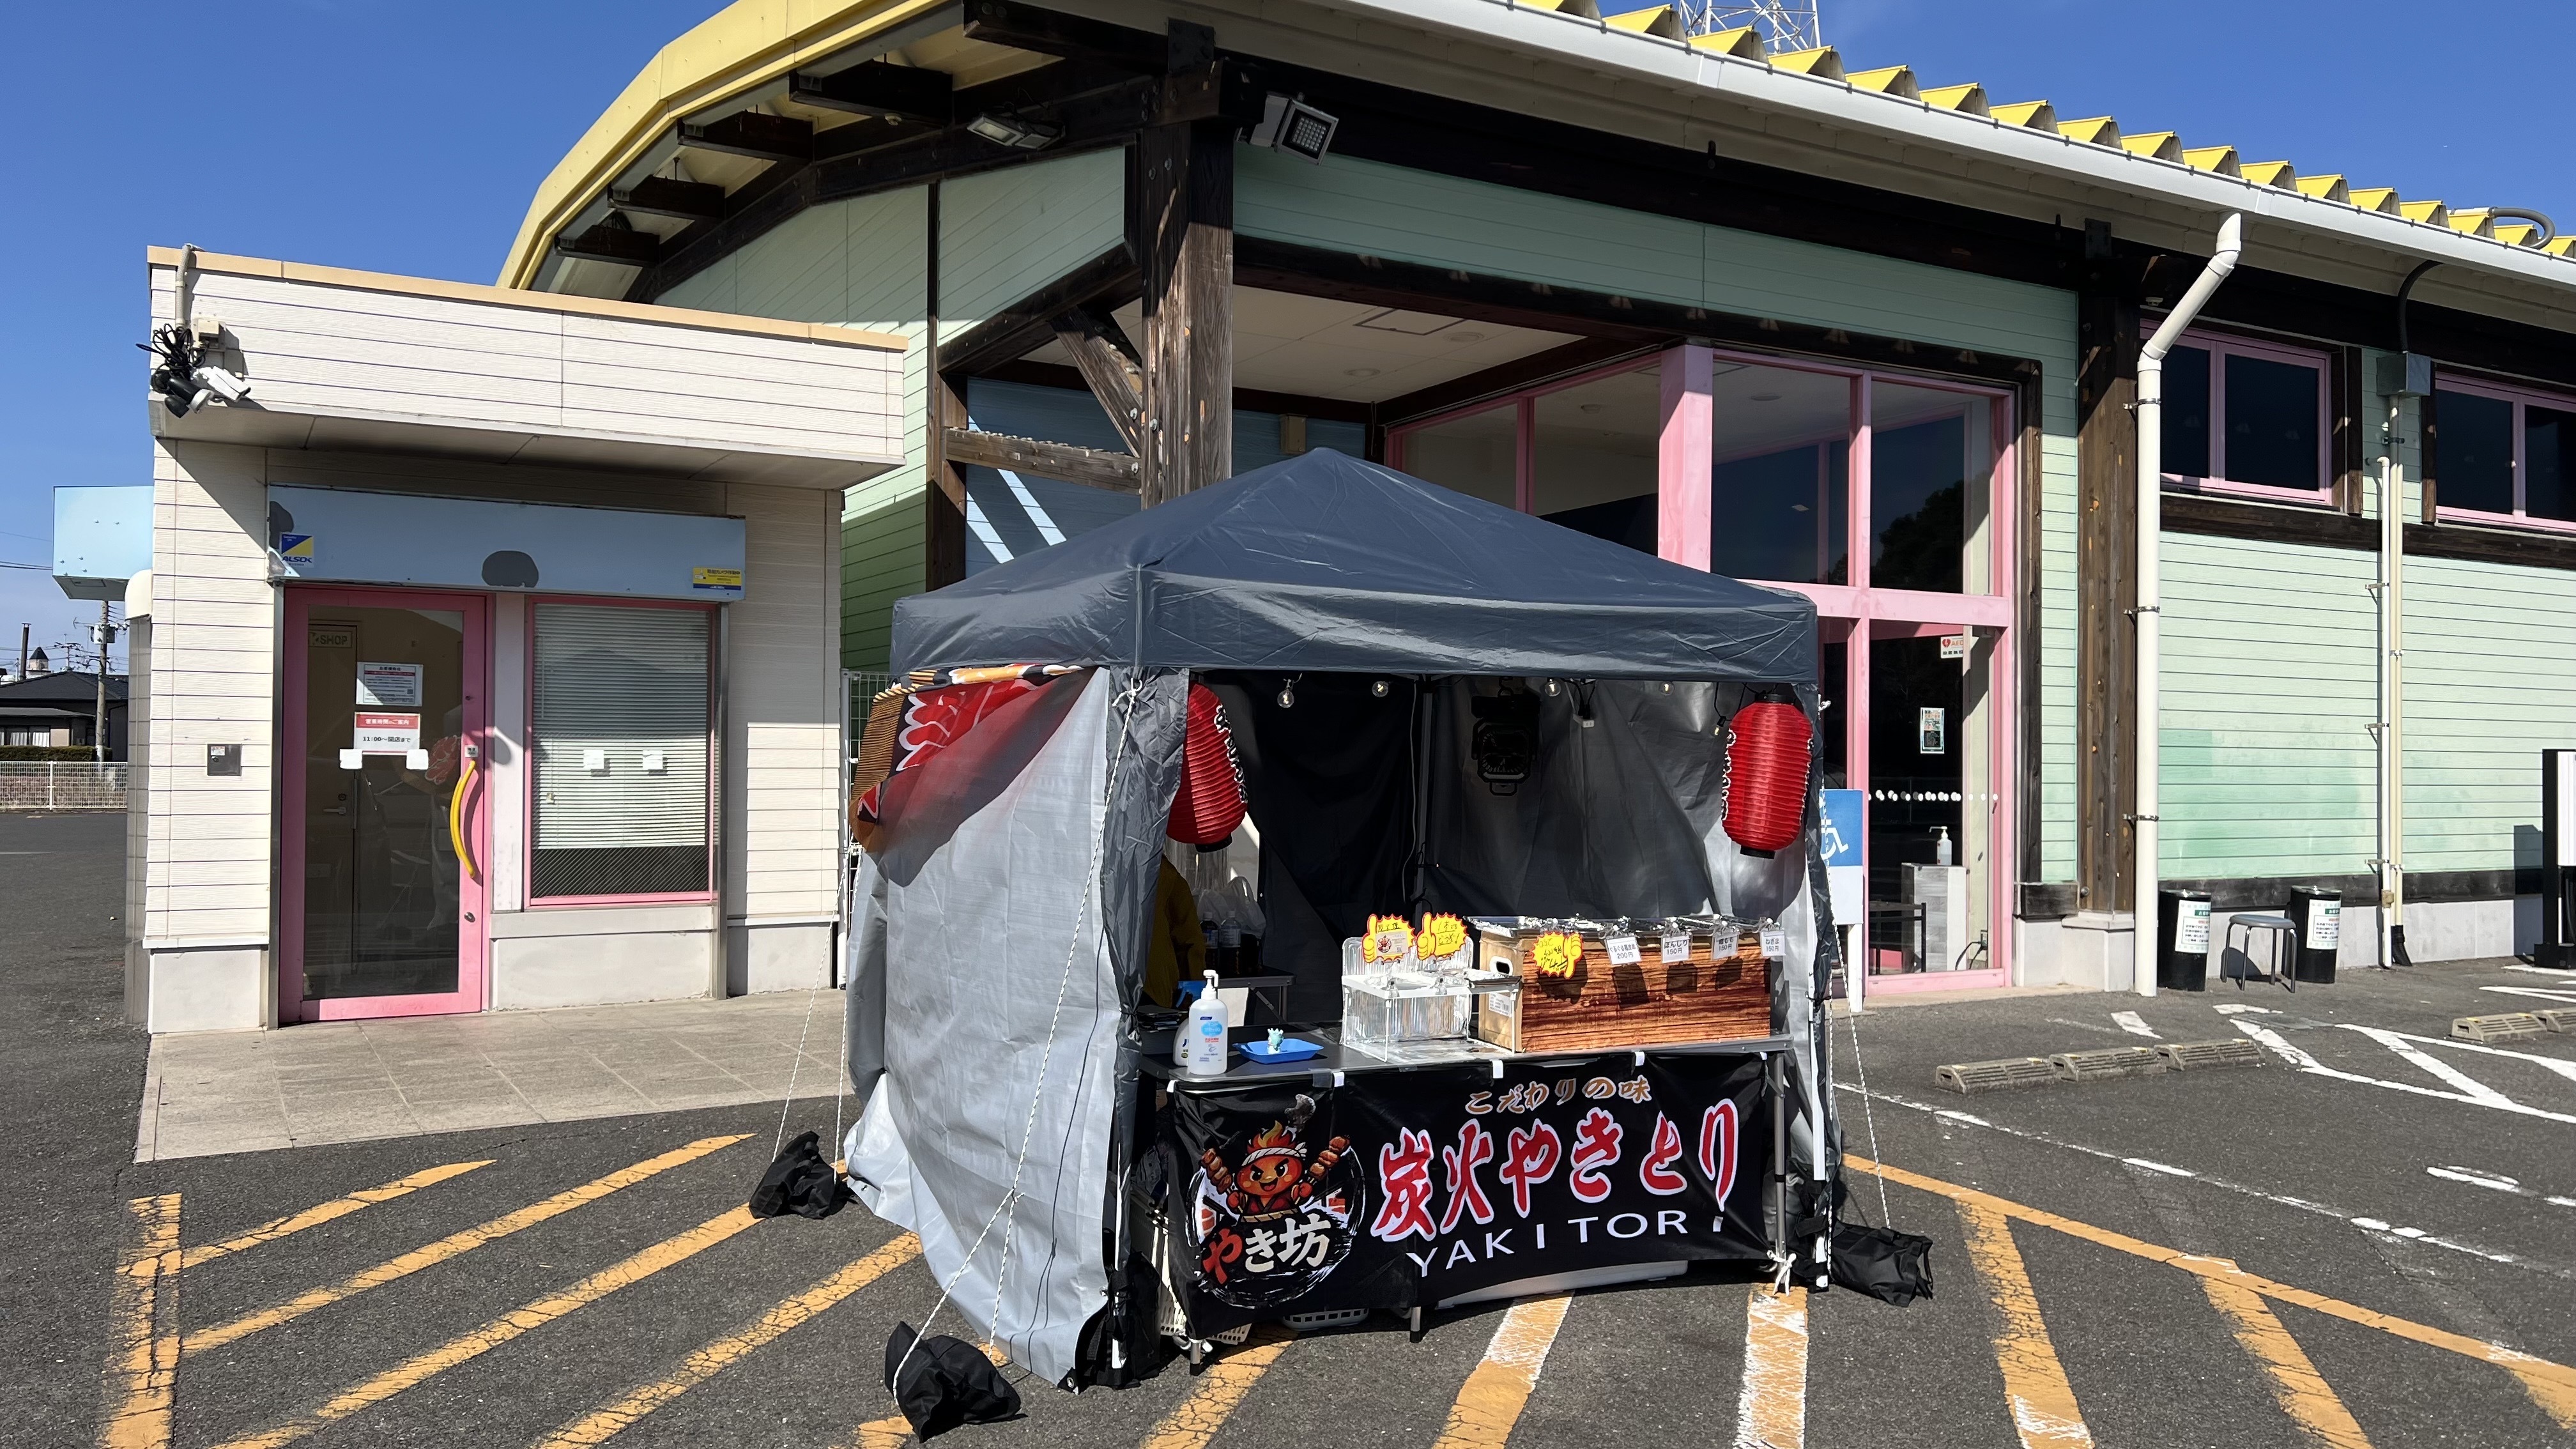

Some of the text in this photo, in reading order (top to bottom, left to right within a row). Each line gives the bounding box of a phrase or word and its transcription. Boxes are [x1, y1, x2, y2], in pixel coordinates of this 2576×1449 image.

[1465, 1075, 1652, 1114] こだわりの味
[1370, 1098, 1738, 1242] 炭火やきとり
[1202, 1213, 1331, 1285] やき坊
